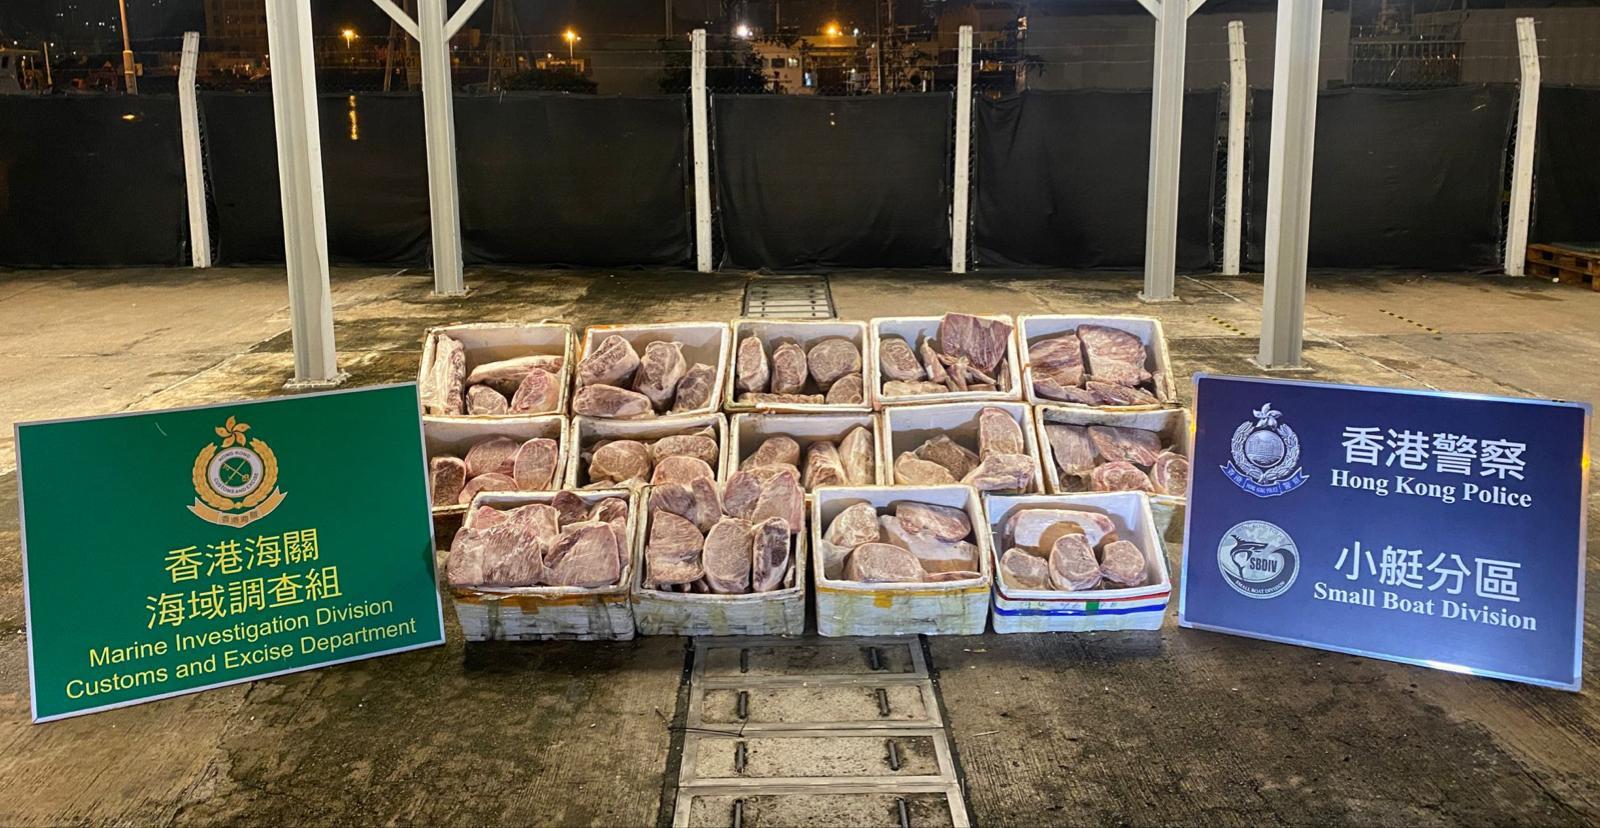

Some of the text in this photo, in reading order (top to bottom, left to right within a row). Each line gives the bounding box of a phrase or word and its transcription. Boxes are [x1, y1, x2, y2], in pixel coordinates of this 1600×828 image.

[1341, 426, 1526, 480] 香港警察
[1330, 469, 1389, 497] Hong
[1394, 474, 1456, 504] Kong
[1462, 482, 1533, 509] Police
[164, 528, 320, 585] 香港海關
[1249, 557, 1278, 573] SBDIV
[1333, 541, 1522, 604] 小艇分區
[145, 565, 344, 629] 海域調查組
[1313, 581, 1537, 631] Small Boat Division
[66, 617, 417, 699] Customs and Excise Department
[89, 600, 394, 668] Marine Investigation Division
